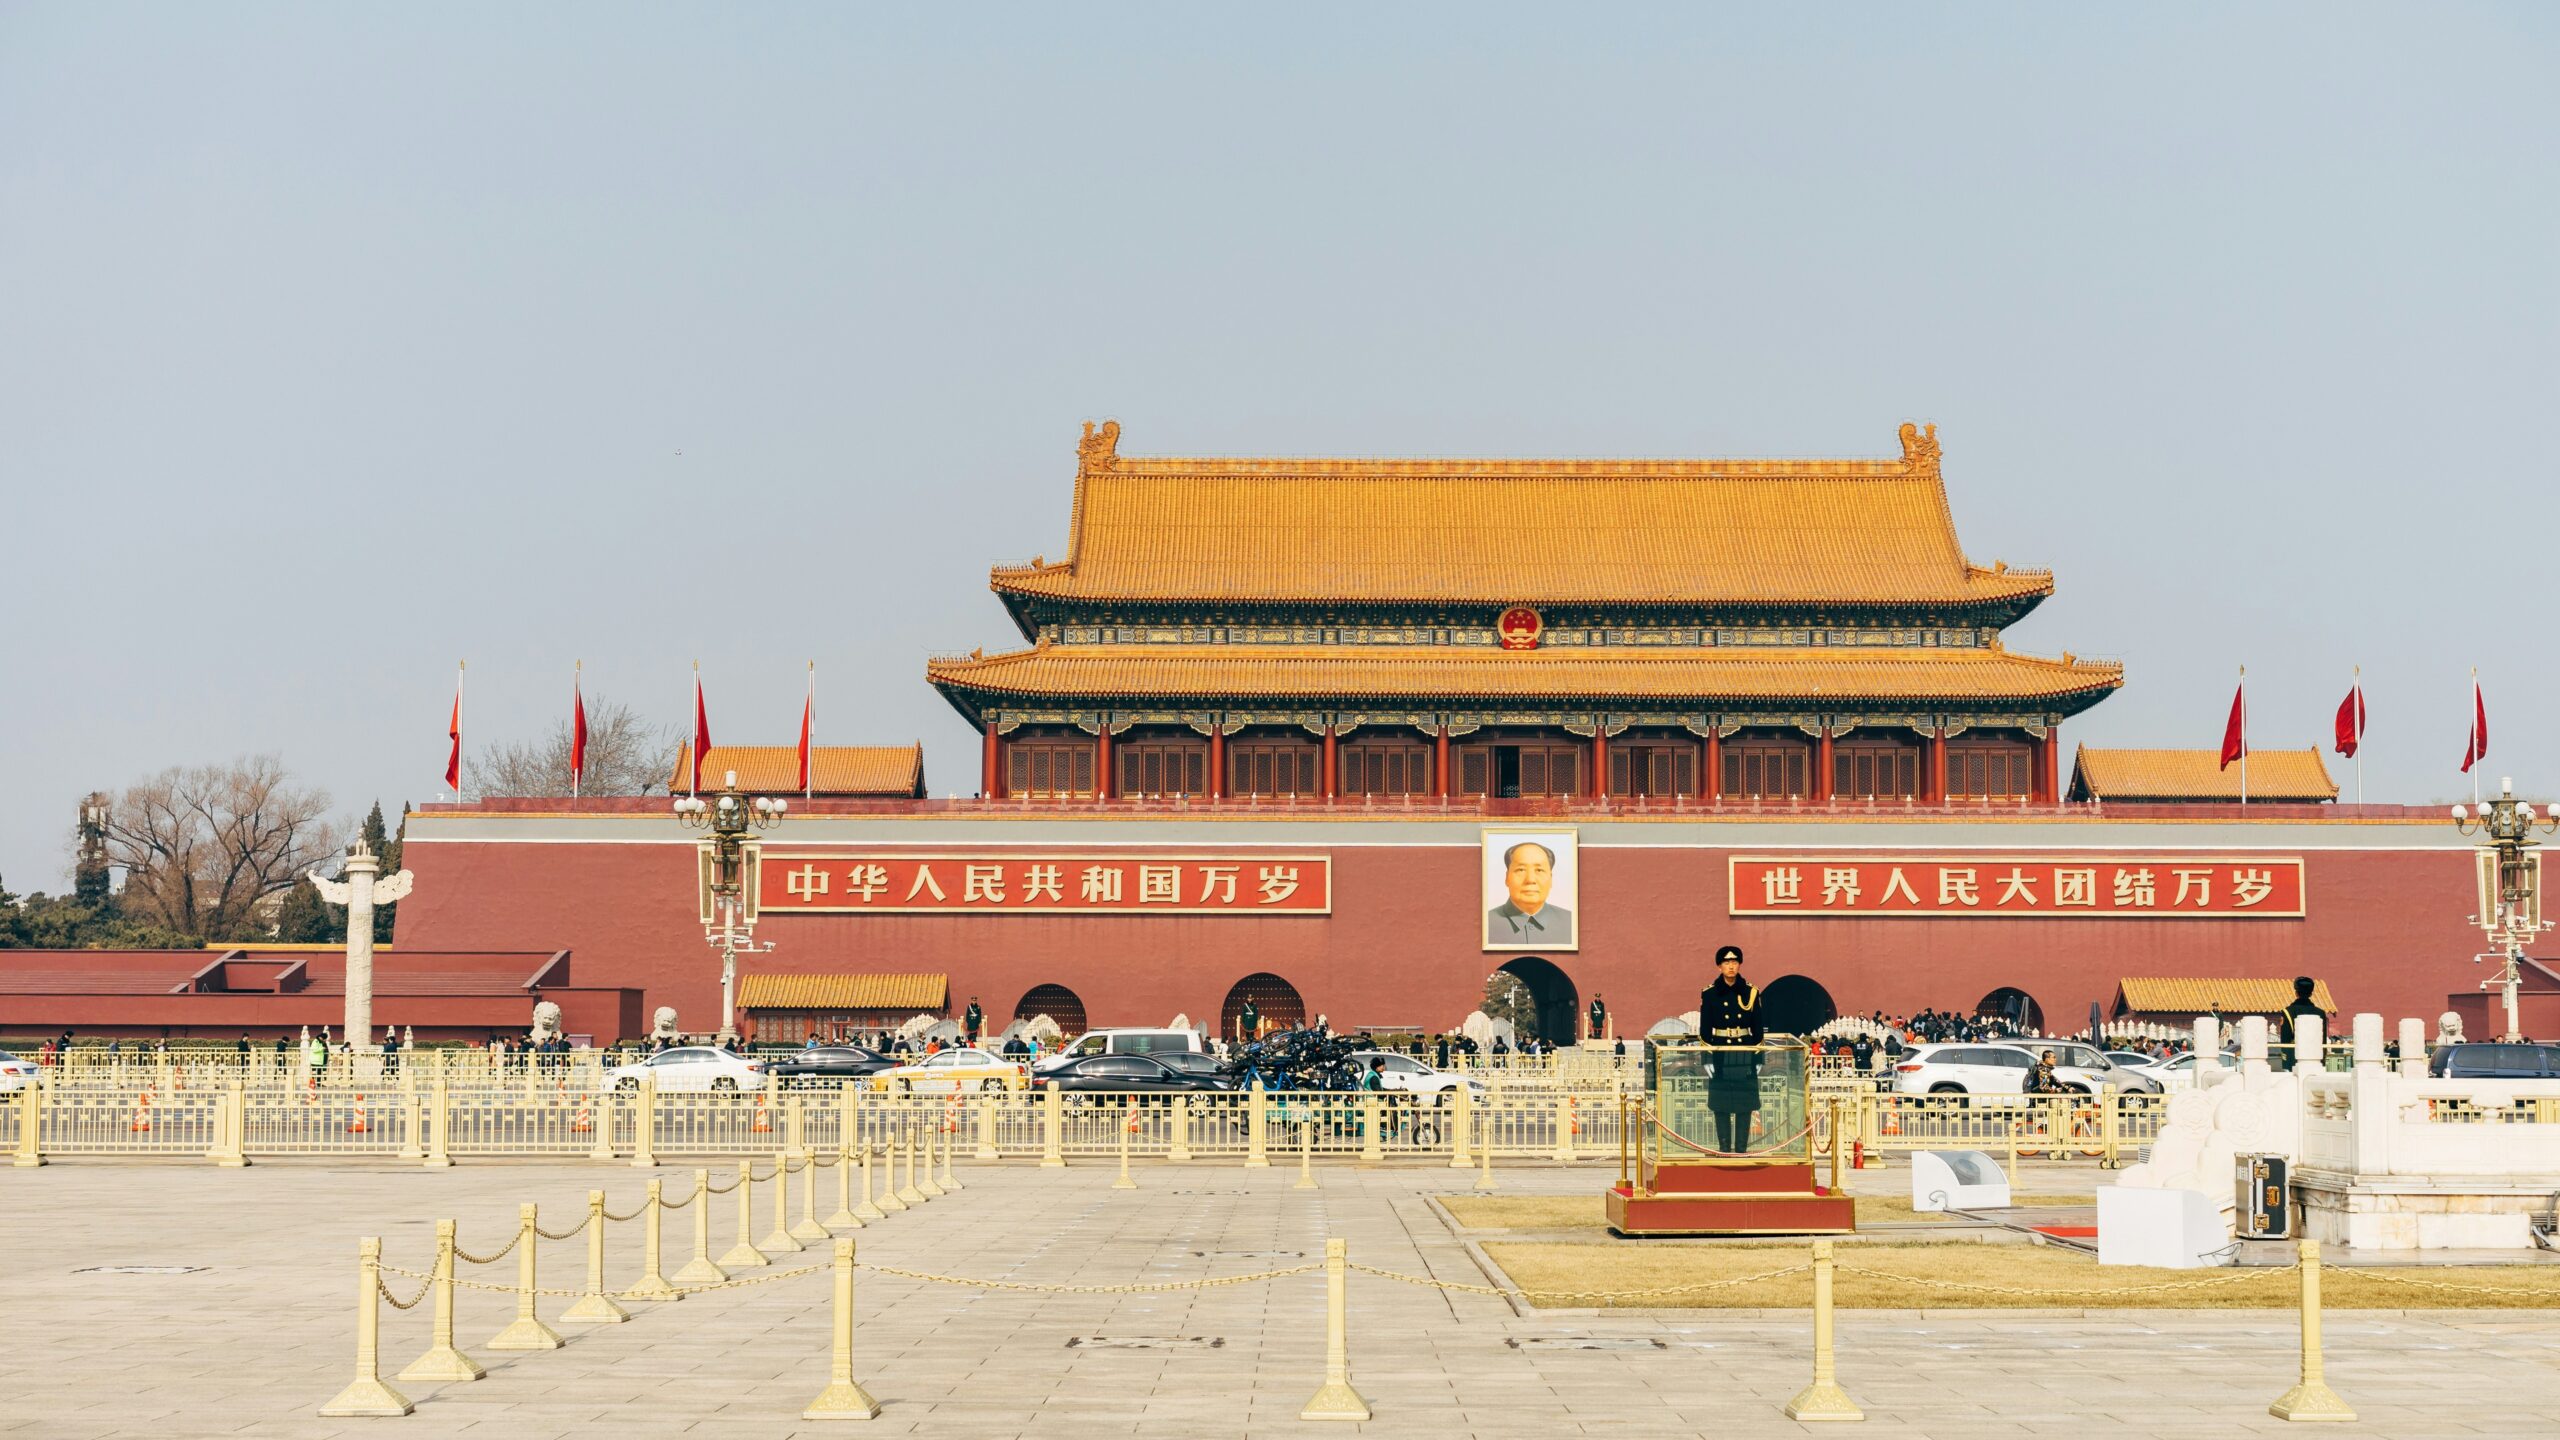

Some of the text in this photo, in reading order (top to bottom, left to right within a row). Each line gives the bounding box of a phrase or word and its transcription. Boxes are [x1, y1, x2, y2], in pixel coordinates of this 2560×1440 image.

[787, 863, 1300, 903] 中华人民共和国万岁
[1761, 867, 2273, 907] 世界人民大团结万岁
